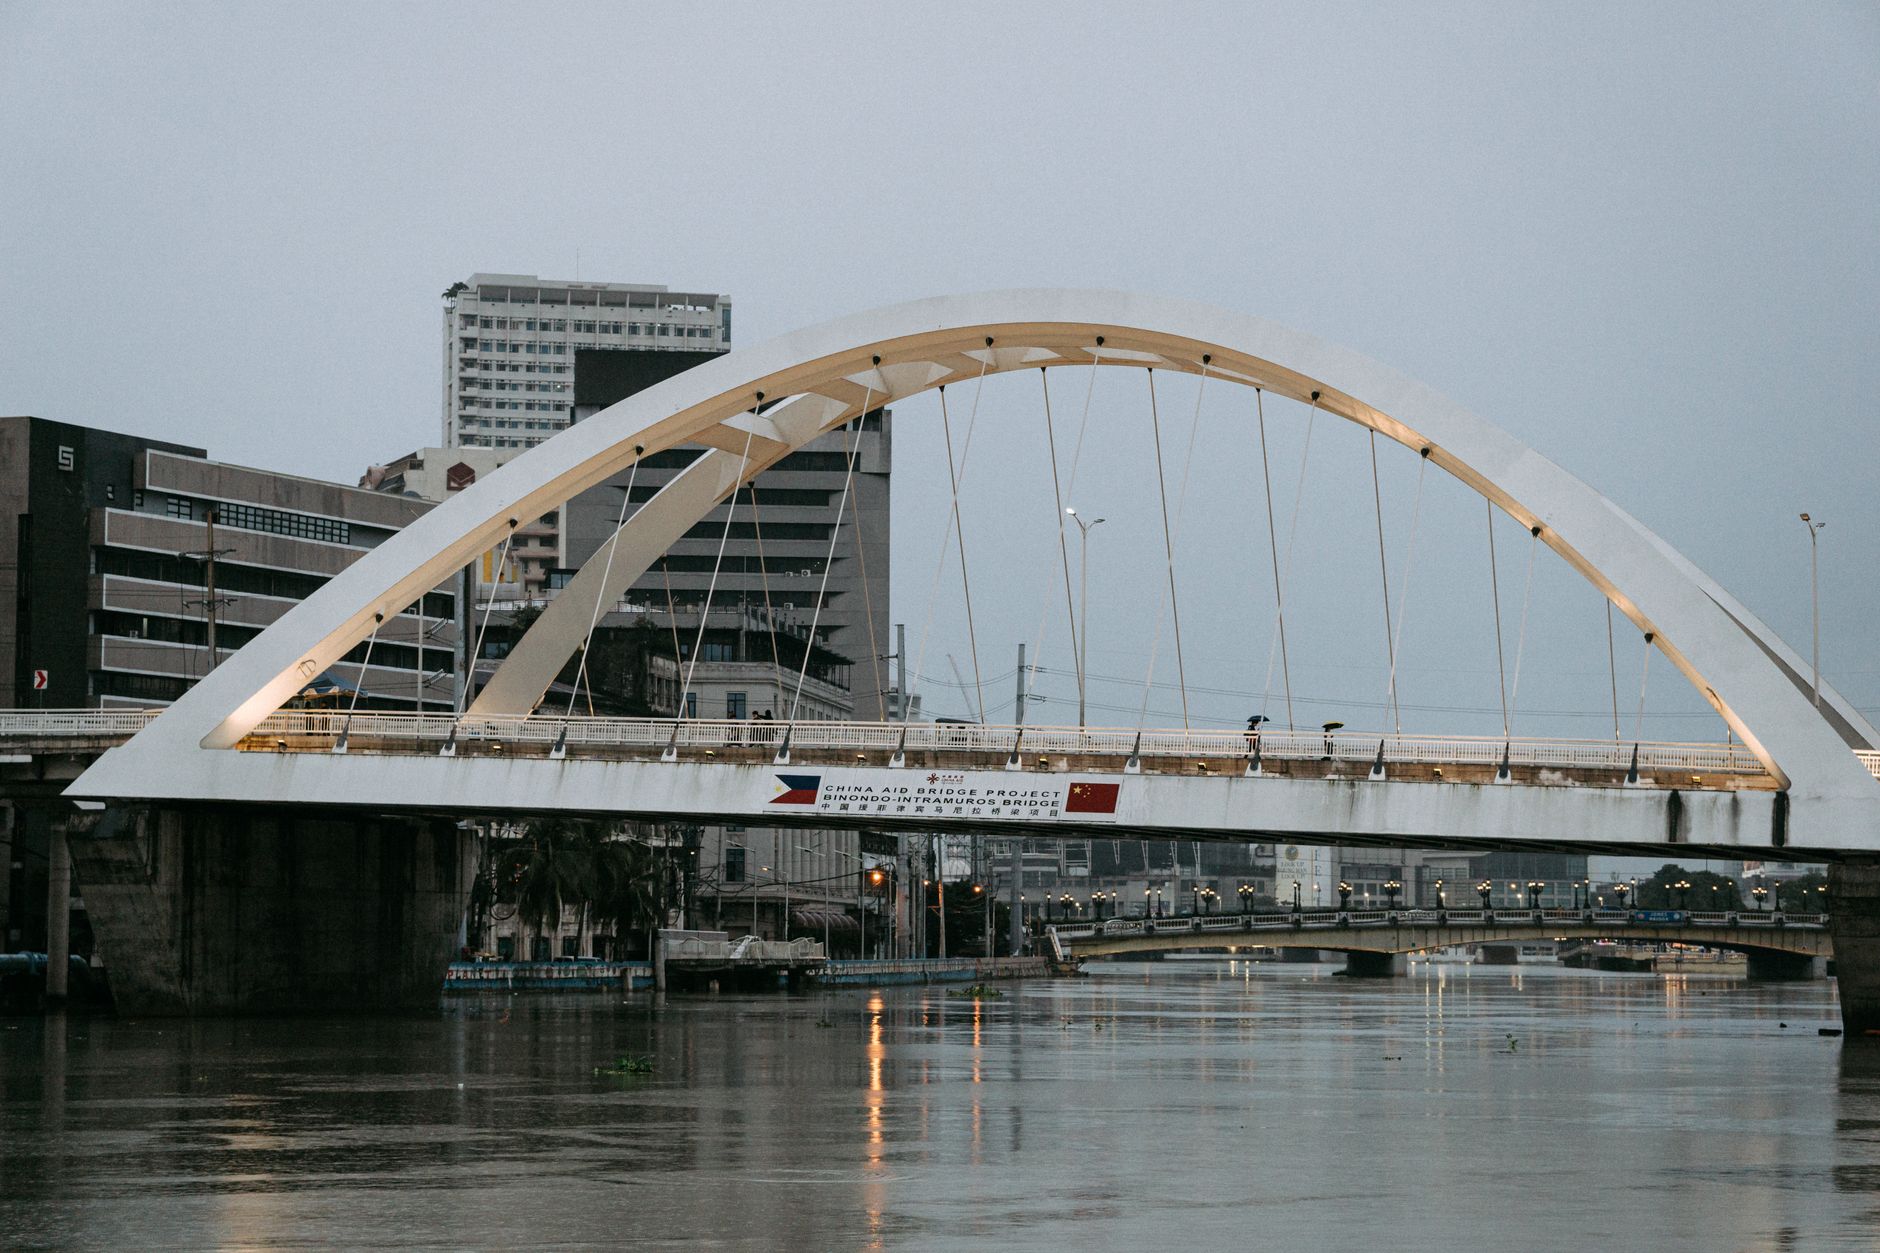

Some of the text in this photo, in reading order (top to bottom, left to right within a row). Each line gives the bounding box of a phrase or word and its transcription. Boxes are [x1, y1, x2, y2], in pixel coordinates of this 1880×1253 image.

[825, 785, 873, 794] CHINA
[917, 788, 977, 796] BRIDGE
[986, 790, 1061, 799] PROJECT
[823, 794, 1060, 808] BINONDO-INTRAMUROS BRIDGE
